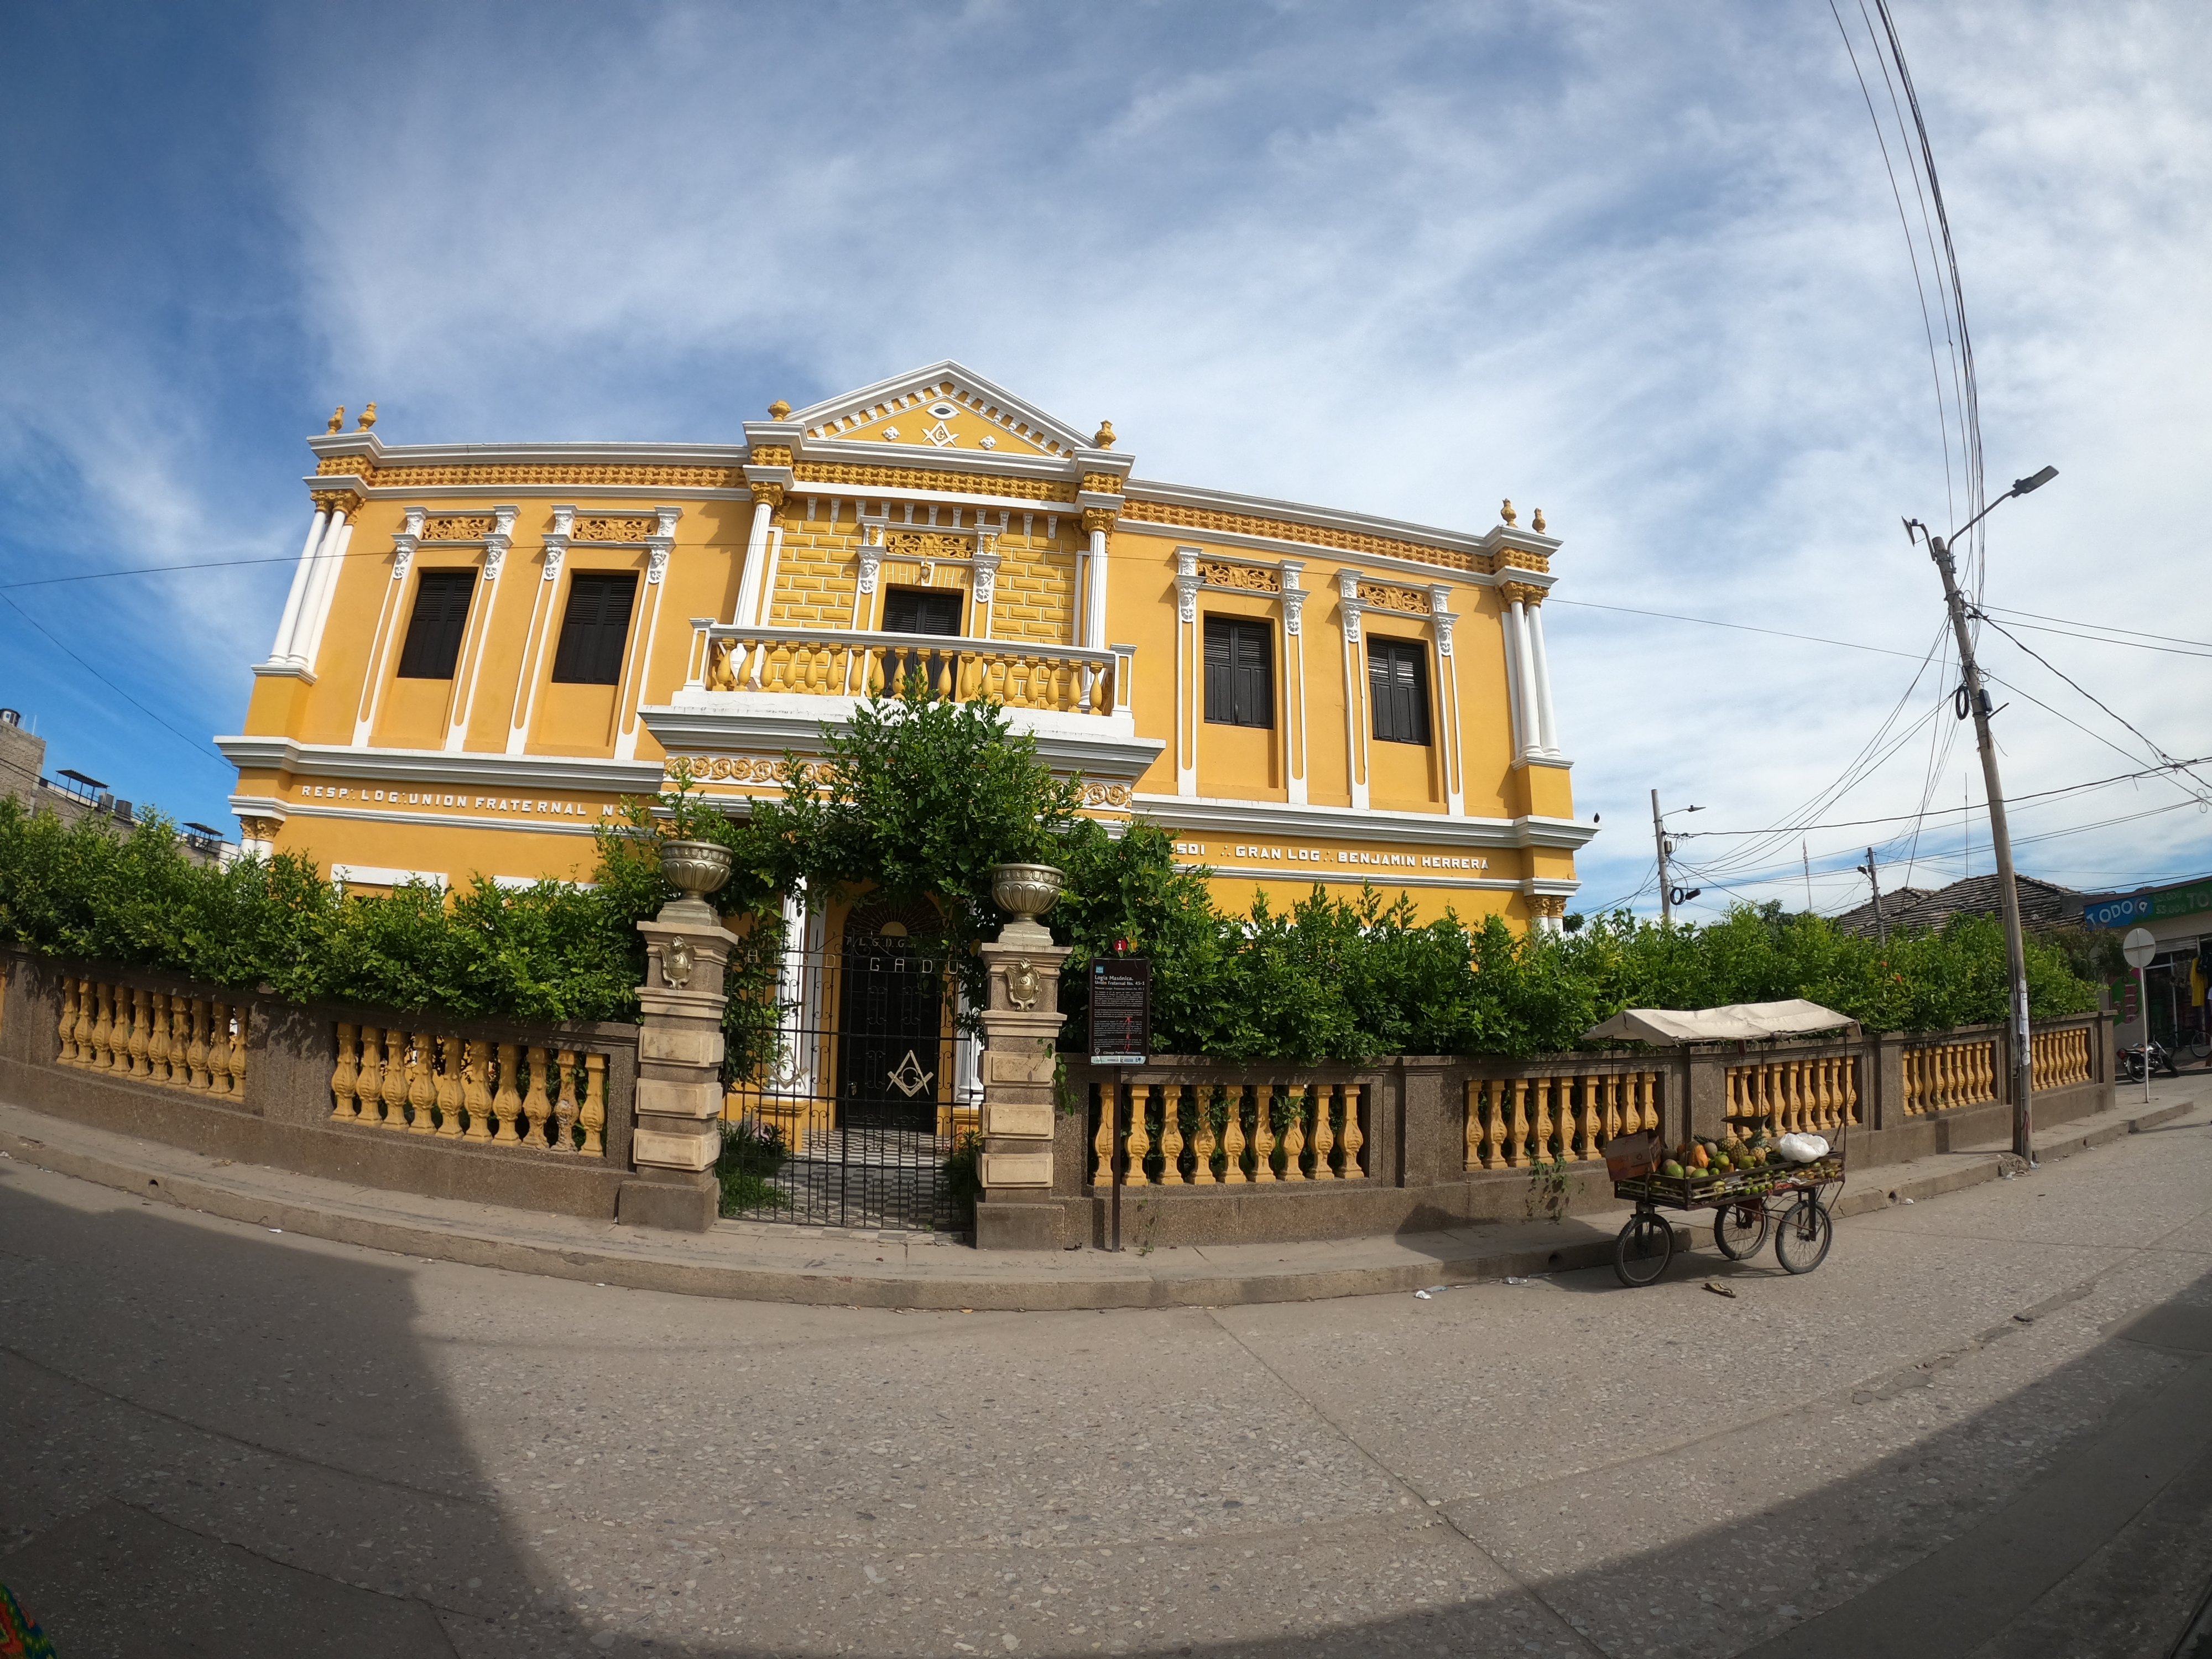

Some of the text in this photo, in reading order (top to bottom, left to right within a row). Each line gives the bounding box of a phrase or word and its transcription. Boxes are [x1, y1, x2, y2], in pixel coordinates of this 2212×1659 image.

[409, 793, 467, 808] UNION
[474, 797, 586, 816] FRATERNAL
[1338, 852, 1416, 867] BENJAMIN
[1422, 857, 1489, 869] HERRERA
[2086, 900, 2133, 927] TODO
